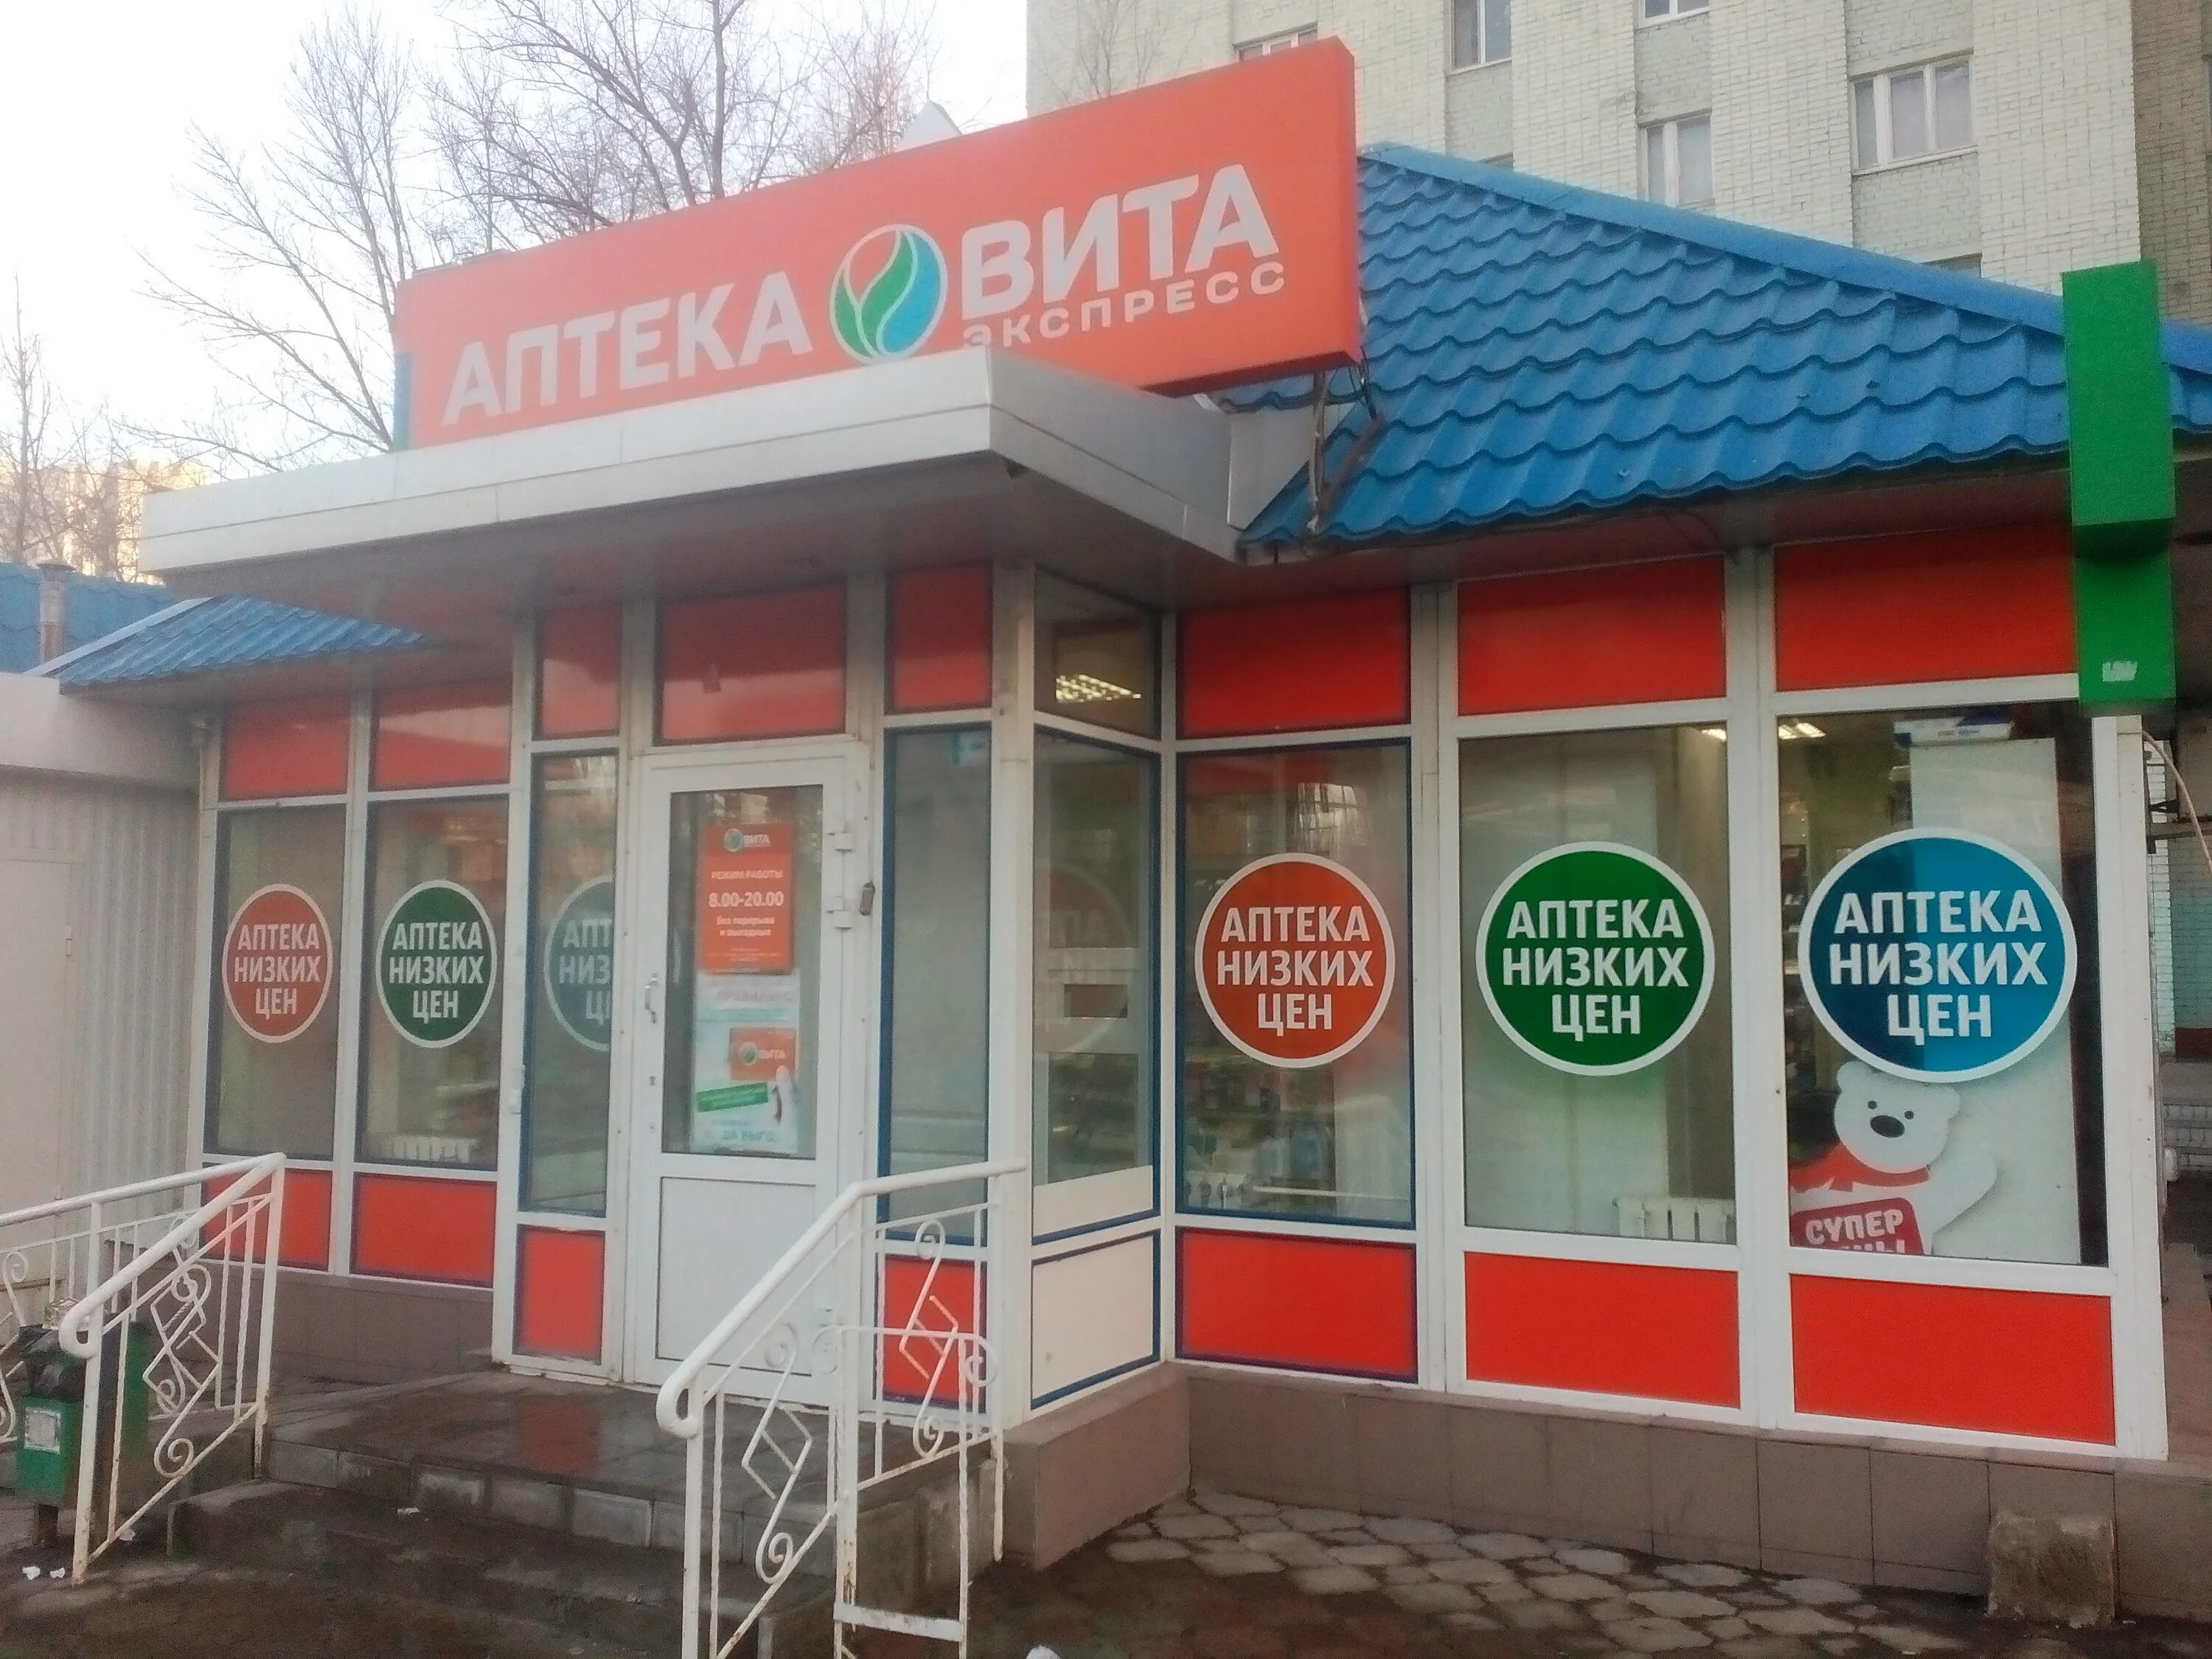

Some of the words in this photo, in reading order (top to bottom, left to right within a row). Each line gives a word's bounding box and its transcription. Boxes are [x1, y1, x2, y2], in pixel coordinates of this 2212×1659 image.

[961, 164, 1279, 320] ВИТА
[962, 261, 1285, 347] ЭКСПРЕСС
[443, 271, 813, 425] АПТЕКА
[711, 871, 744, 880] РЕЖИМ
[745, 869, 784, 879] РАБОТЫ
[708, 891, 785, 908] 8.00-20.00
[1834, 889, 2042, 934] АПТЕКА
[237, 923, 320, 950] АПТЕКА
[392, 922, 483, 950] АПТЕКА
[1220, 906, 1370, 942] АПТЕКА
[1506, 899, 1684, 939] АПТЕКА
[234, 956, 321, 983] НИЗКИХ
[389, 956, 484, 985] НИЗКИХ
[1217, 950, 1374, 987] НИЗКИХ
[1503, 947, 1689, 987] НИЗКИХ
[1829, 942, 2048, 986] НИЗКИХ
[255, 987, 298, 1020] ЦЕН
[412, 990, 459, 1023] ЦЕН
[1258, 993, 1332, 1037] ЦЕН
[1551, 994, 1641, 1042] ЦЕН
[1887, 994, 1992, 1046] ЦЕН
[1806, 1208, 1904, 1245] СУПЕР
